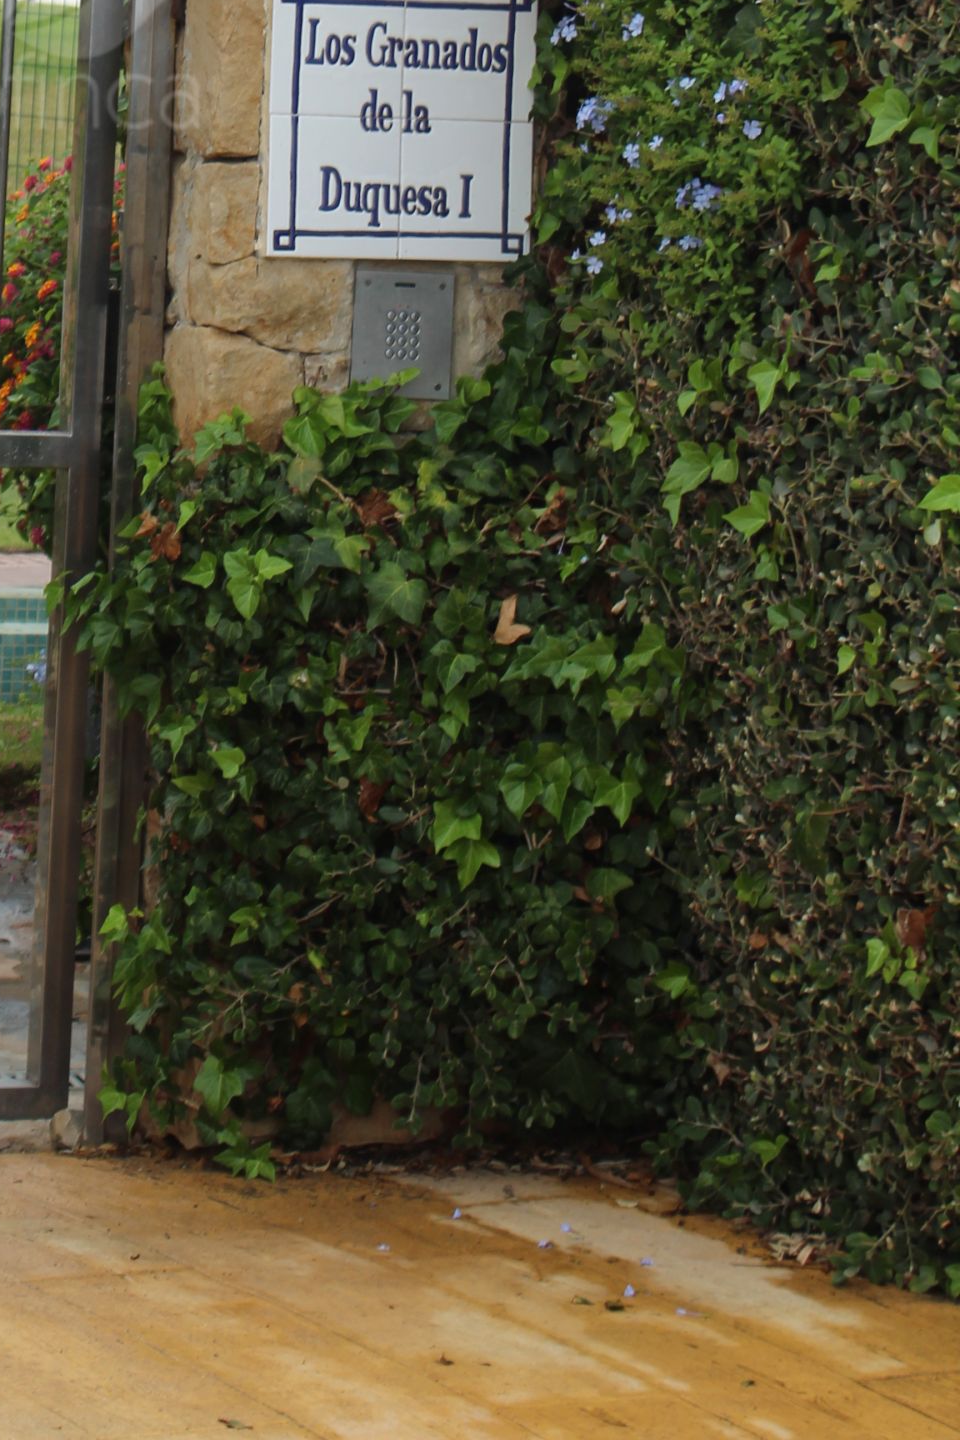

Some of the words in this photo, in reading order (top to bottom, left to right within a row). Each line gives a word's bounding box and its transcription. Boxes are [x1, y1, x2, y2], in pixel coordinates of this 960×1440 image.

[305, 18, 357, 66] Los
[365, 21, 510, 73] Granados
[360, 88, 393, 132] de
[402, 90, 431, 134] la
[319, 166, 449, 227] Duquesa
[458, 174, 474, 218] I
